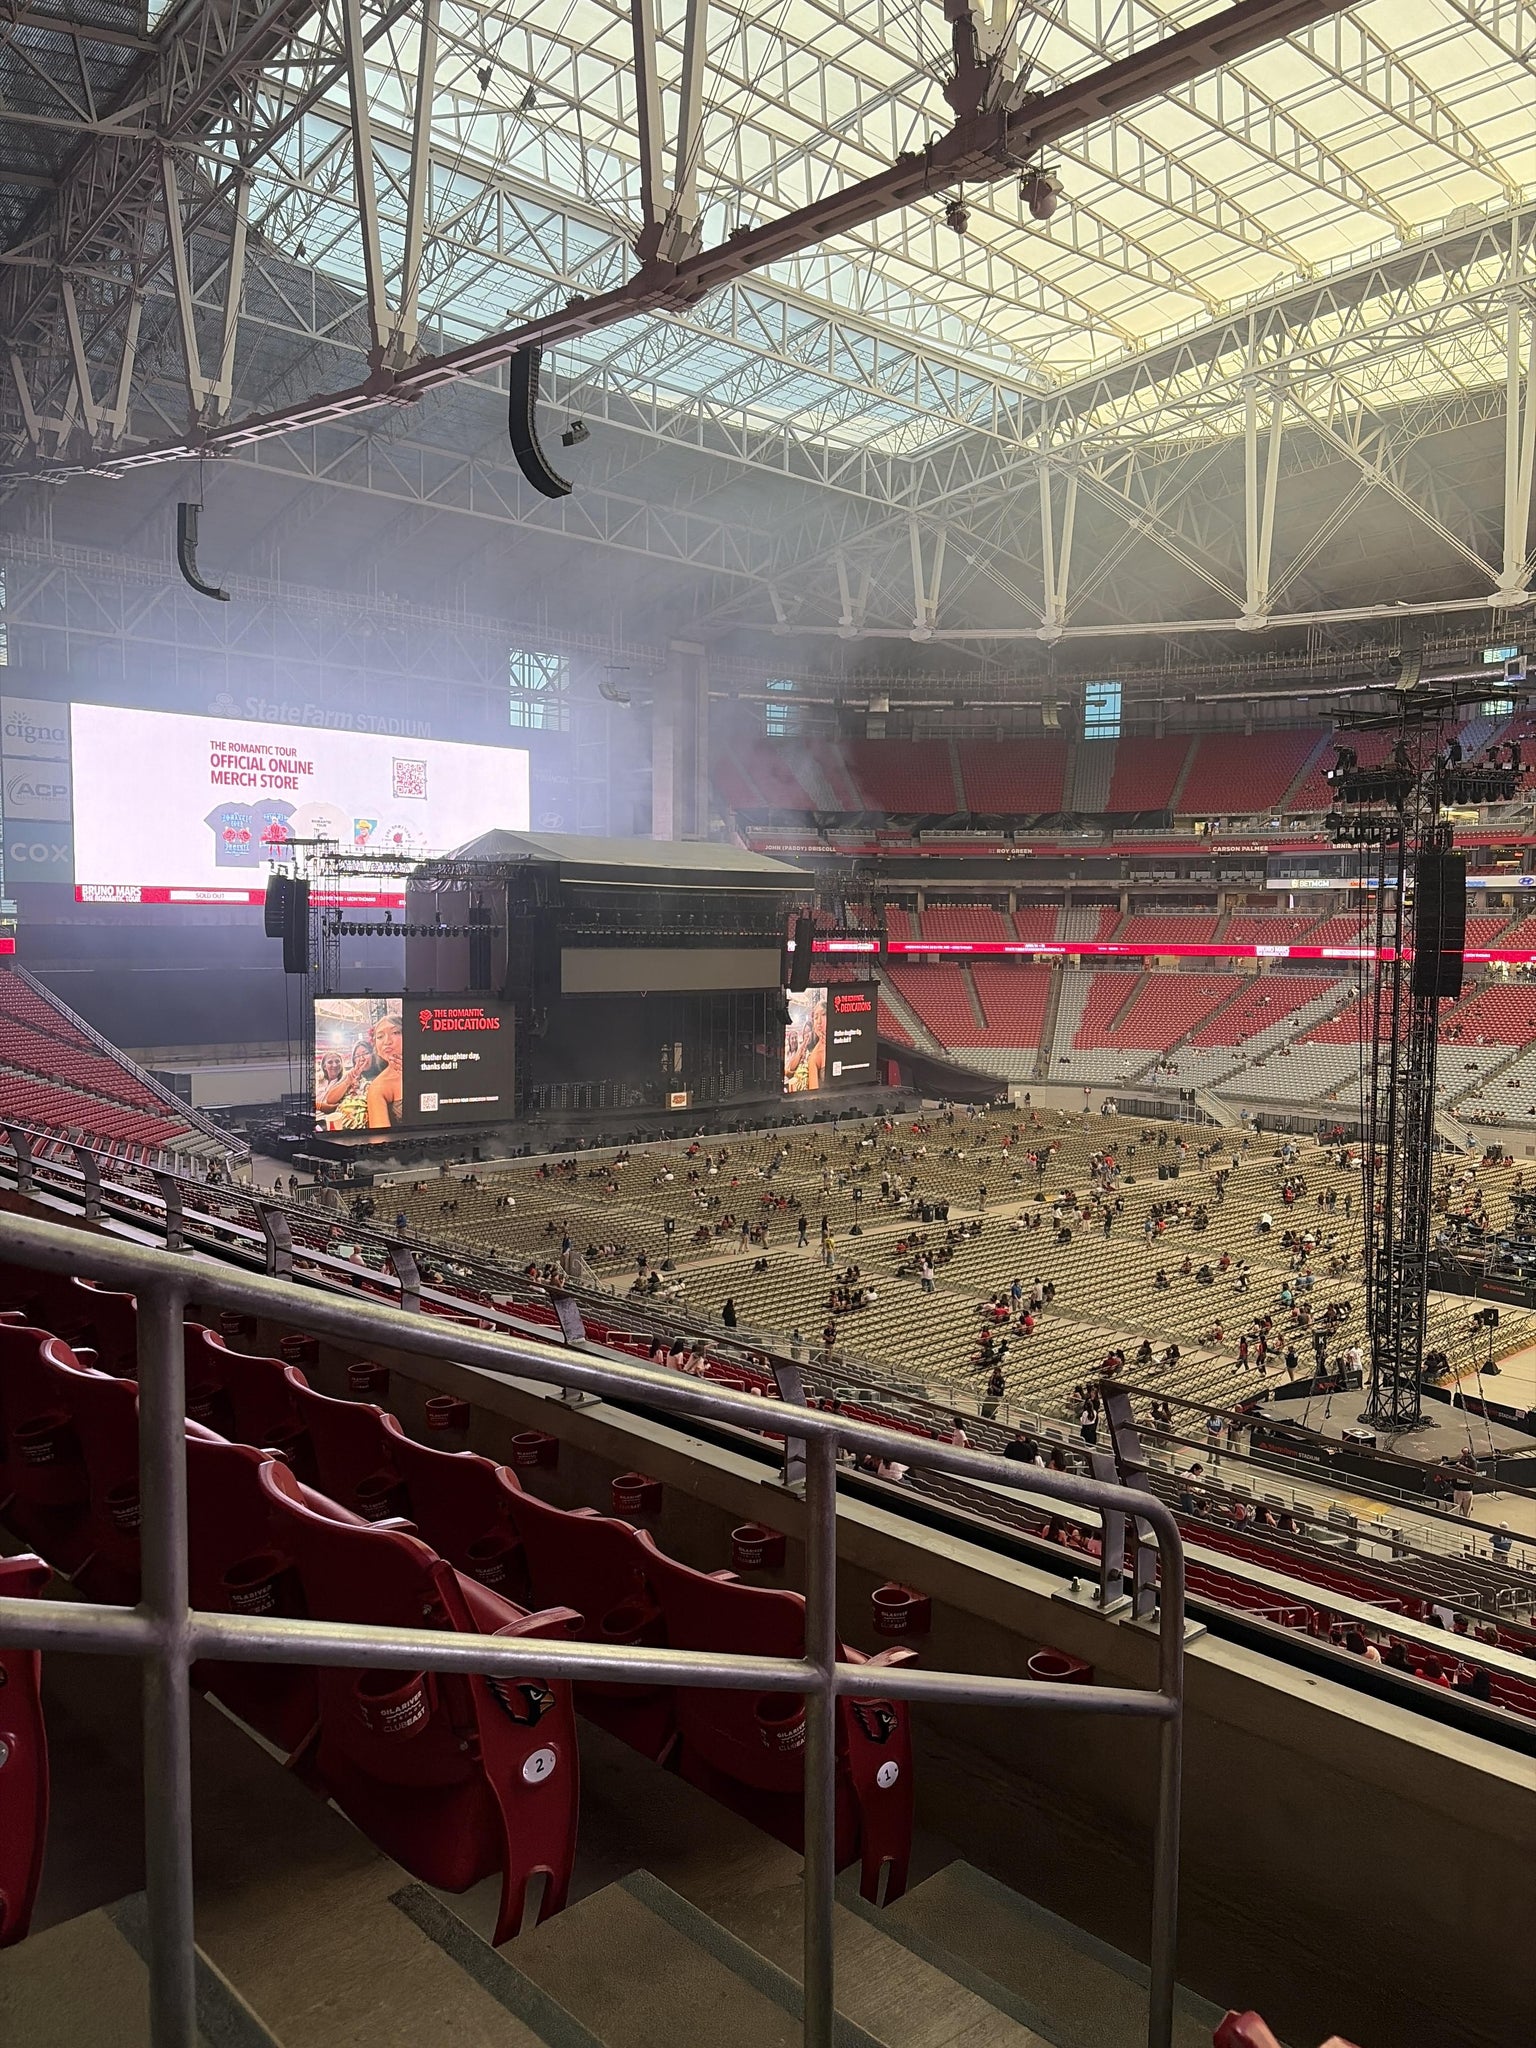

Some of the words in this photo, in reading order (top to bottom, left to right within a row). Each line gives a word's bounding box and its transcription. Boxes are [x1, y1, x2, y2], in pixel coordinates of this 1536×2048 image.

[357, 713, 432, 738] STADIUM
[5, 721, 66, 743] cigna
[210, 740, 226, 751] THE
[228, 742, 273, 755] ROMANTIC
[274, 746, 297, 757] TOUR
[210, 753, 266, 771] OFFICIAL
[268, 758, 314, 775] ONLINE
[211, 770, 257, 787] MERCH
[260, 774, 299, 790] STORE
[16, 783, 68, 797] ACP
[10, 842, 69, 863] COX
[1299, 880, 1330, 888] BETMGM
[82, 885, 114, 896] BRUNO
[115, 886, 141, 897] MARS
[433, 1009, 447, 1018] THE
[448, 1008, 484, 1017] ROMANTIC
[840, 1002, 872, 1013] DEDICATIONS
[433, 1018, 500, 1031] DEDICATIONS
[421, 1053, 442, 1061] Mother
[442, 1052, 468, 1061] daughter
[421, 1063, 441, 1071] thanks
[441, 1062, 452, 1070] dad
[1318, 1336, 1325, 1344] K
[1298, 1452, 1320, 1462] STADIUM
[535, 1758, 544, 1773] 2
[885, 1769, 891, 1781] 1
